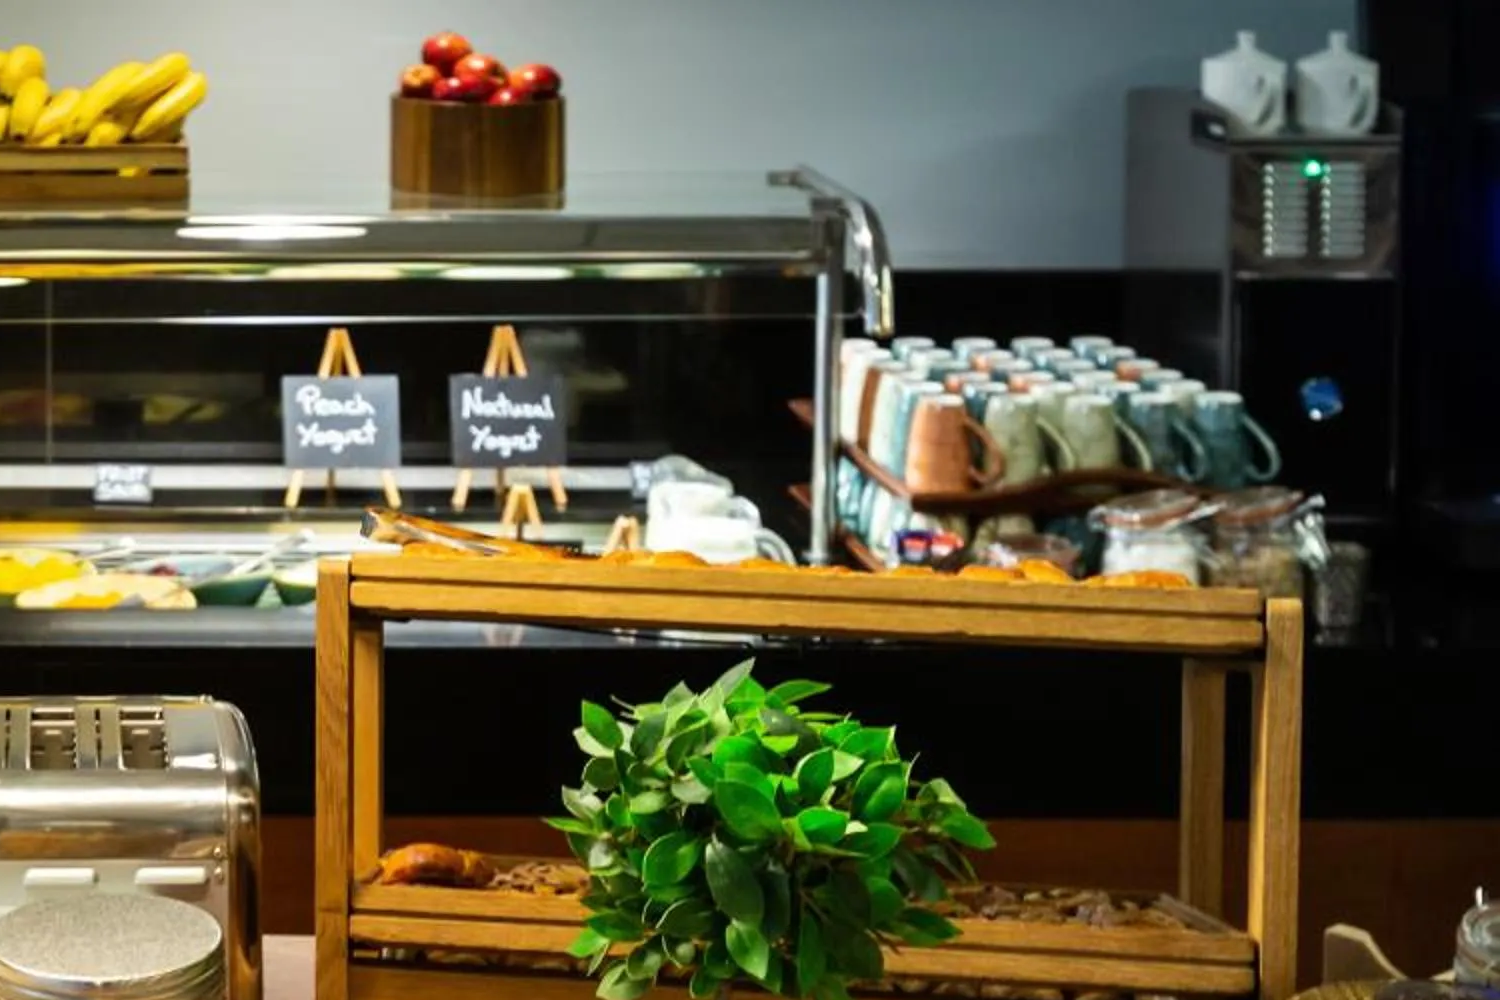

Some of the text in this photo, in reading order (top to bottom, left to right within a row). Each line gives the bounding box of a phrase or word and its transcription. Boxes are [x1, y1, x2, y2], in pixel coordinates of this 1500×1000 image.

[296, 384, 376, 417] Peach
[461, 386, 555, 420] Natural
[296, 418, 378, 455] Yogurt
[468, 424, 542, 459] Yogurt
